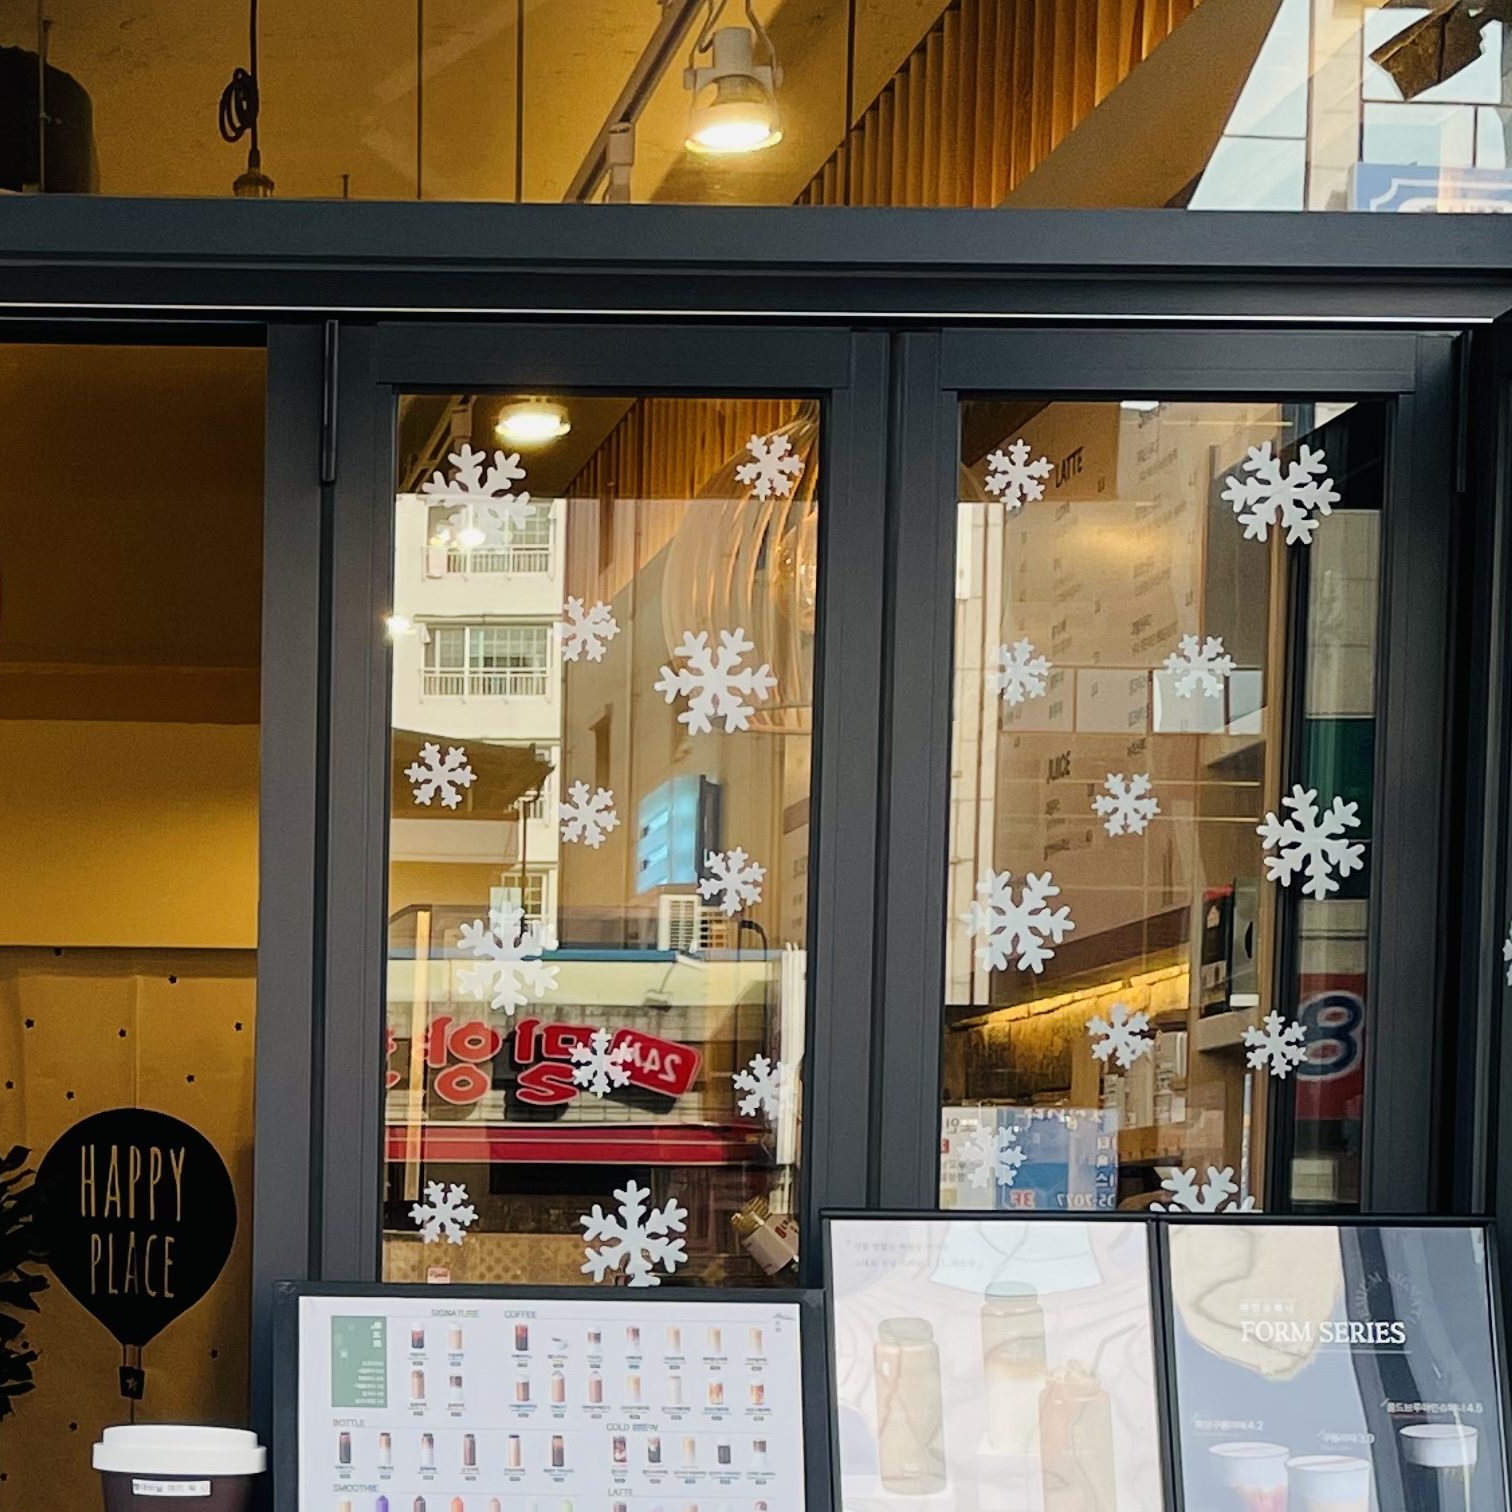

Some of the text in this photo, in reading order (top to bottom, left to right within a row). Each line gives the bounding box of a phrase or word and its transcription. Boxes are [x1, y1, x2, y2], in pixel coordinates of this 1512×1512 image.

[81, 1144, 186, 1222] HAPPY
[90, 1231, 176, 1298] PLACE
[1240, 1320, 1407, 1344] FORM SERIES
